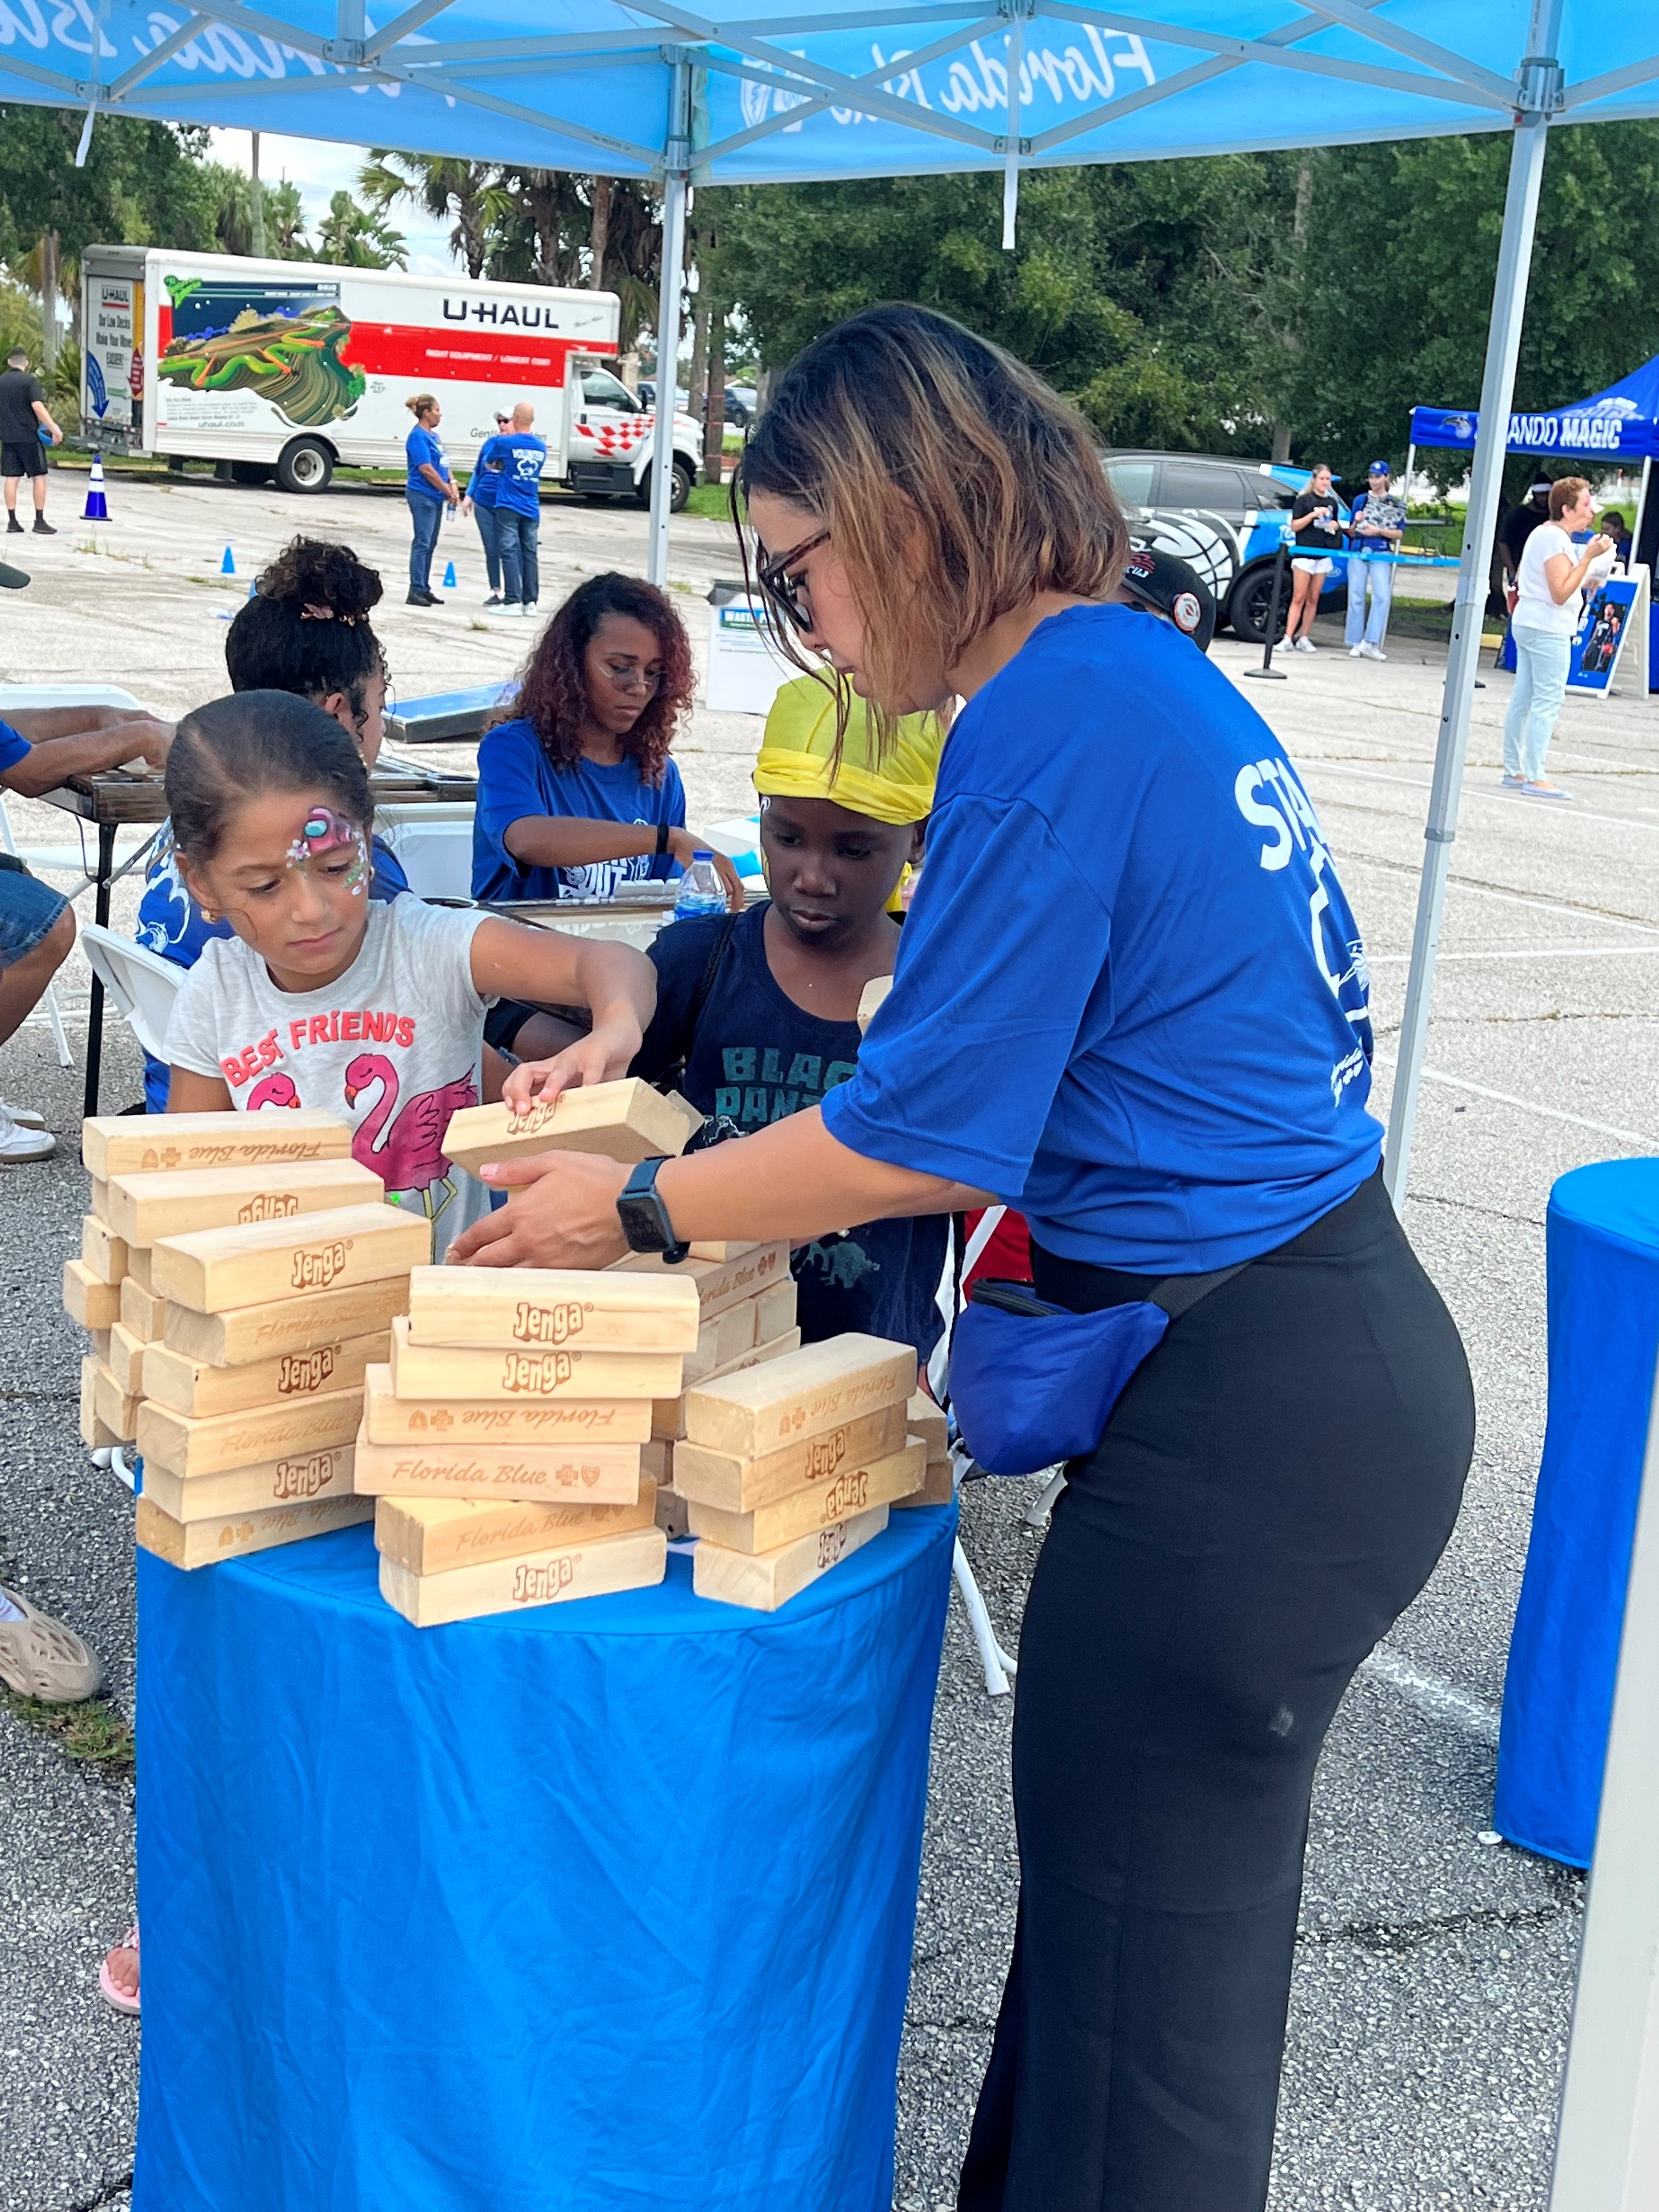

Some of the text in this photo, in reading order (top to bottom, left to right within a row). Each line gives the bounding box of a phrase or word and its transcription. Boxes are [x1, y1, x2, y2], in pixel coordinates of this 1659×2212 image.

[425, 348, 449, 358] RIGHT
[449, 349, 493, 362] EQUIPMENT
[500, 355, 530, 365] LOWEST
[531, 357, 551, 366] COST
[198, 420, 245, 428] uhaul.com
[1560, 416, 1623, 450] MAGIC
[221, 1029, 284, 1087] BEST
[721, 1047, 858, 1093] BLAC
[188, 1141, 322, 1165] Florida Blue
[732, 1266, 755, 1290] Blue
[811, 1373, 898, 1420] Florida Blue
[462, 1408, 615, 1430] Florida Blue
[220, 1422, 301, 1455] Florida
[392, 1460, 547, 1485] Florida Blue
[455, 1508, 584, 1554] Florida Blue
